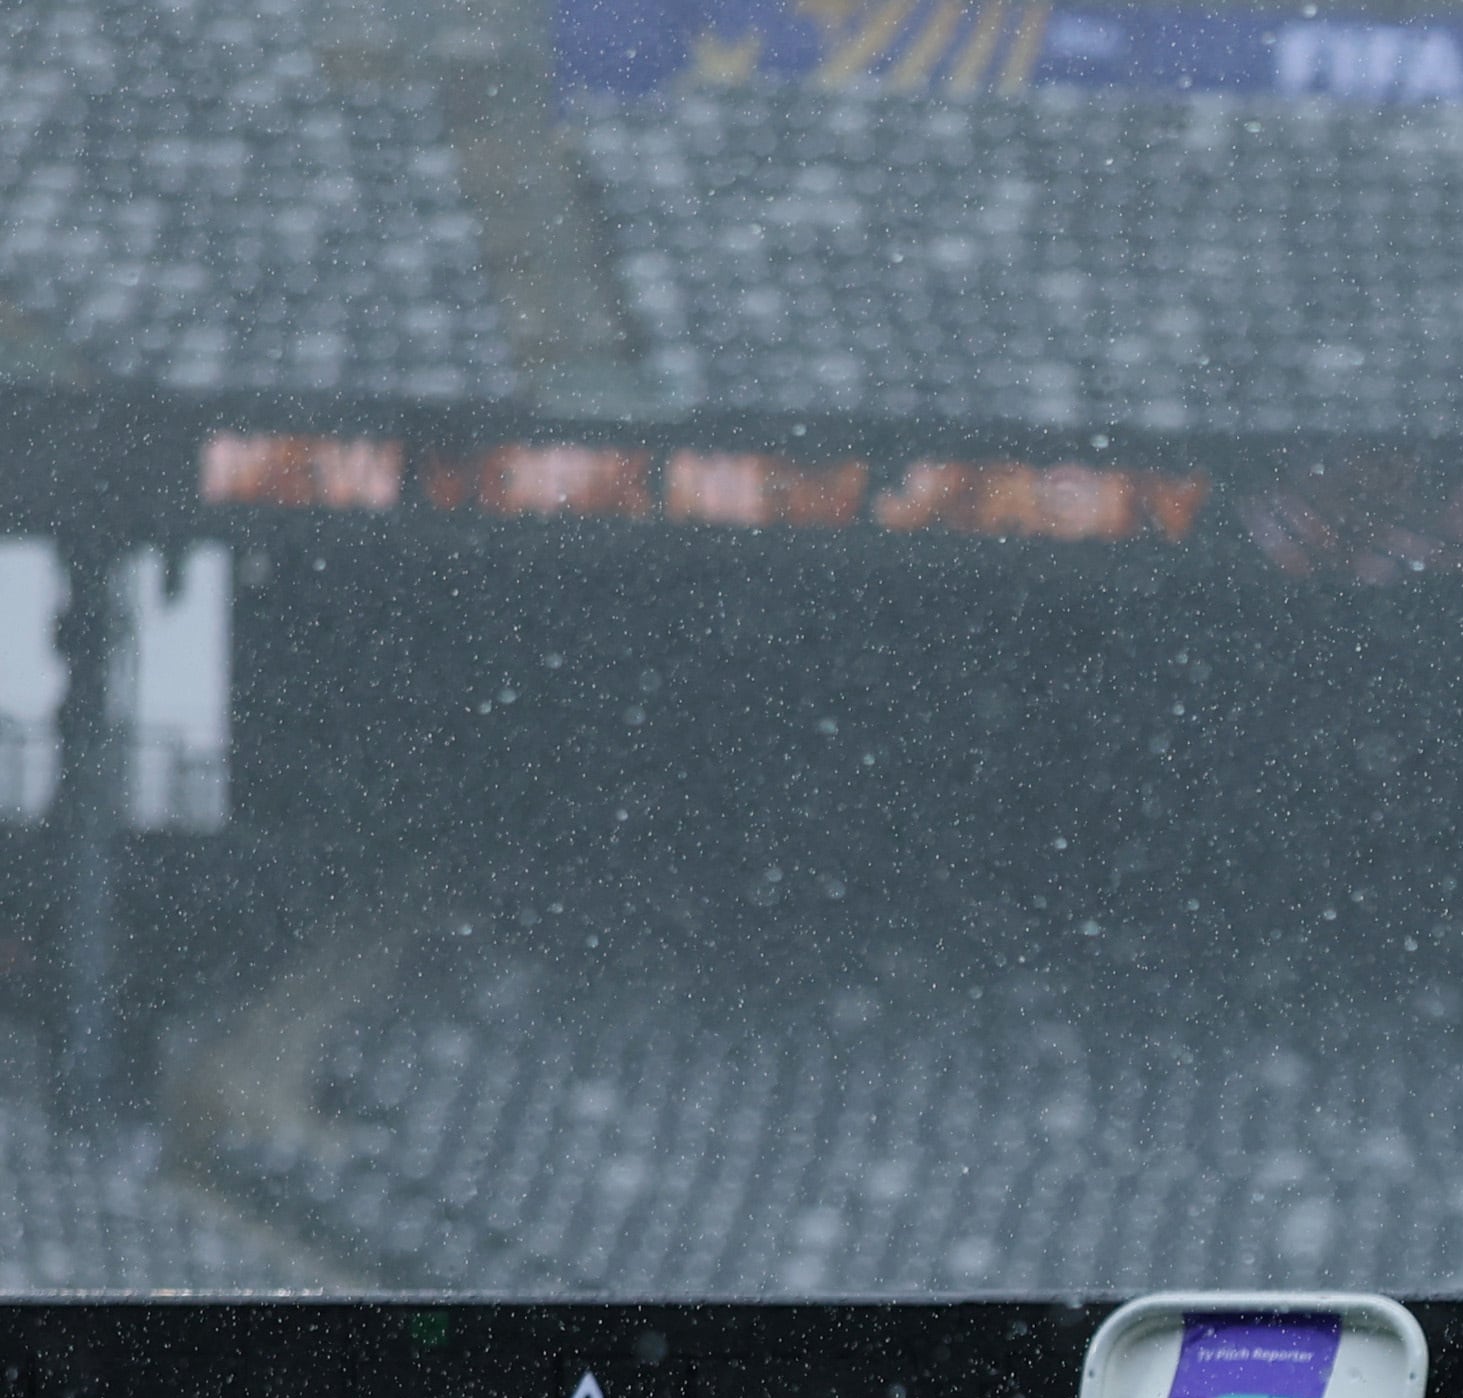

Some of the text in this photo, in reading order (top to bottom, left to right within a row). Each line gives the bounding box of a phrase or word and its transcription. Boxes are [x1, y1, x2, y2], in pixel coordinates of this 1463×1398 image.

[1276, 28, 1463, 98] FIFA
[1216, 1347, 1250, 1361] Pitch
[1252, 1347, 1314, 1363] Reporter
